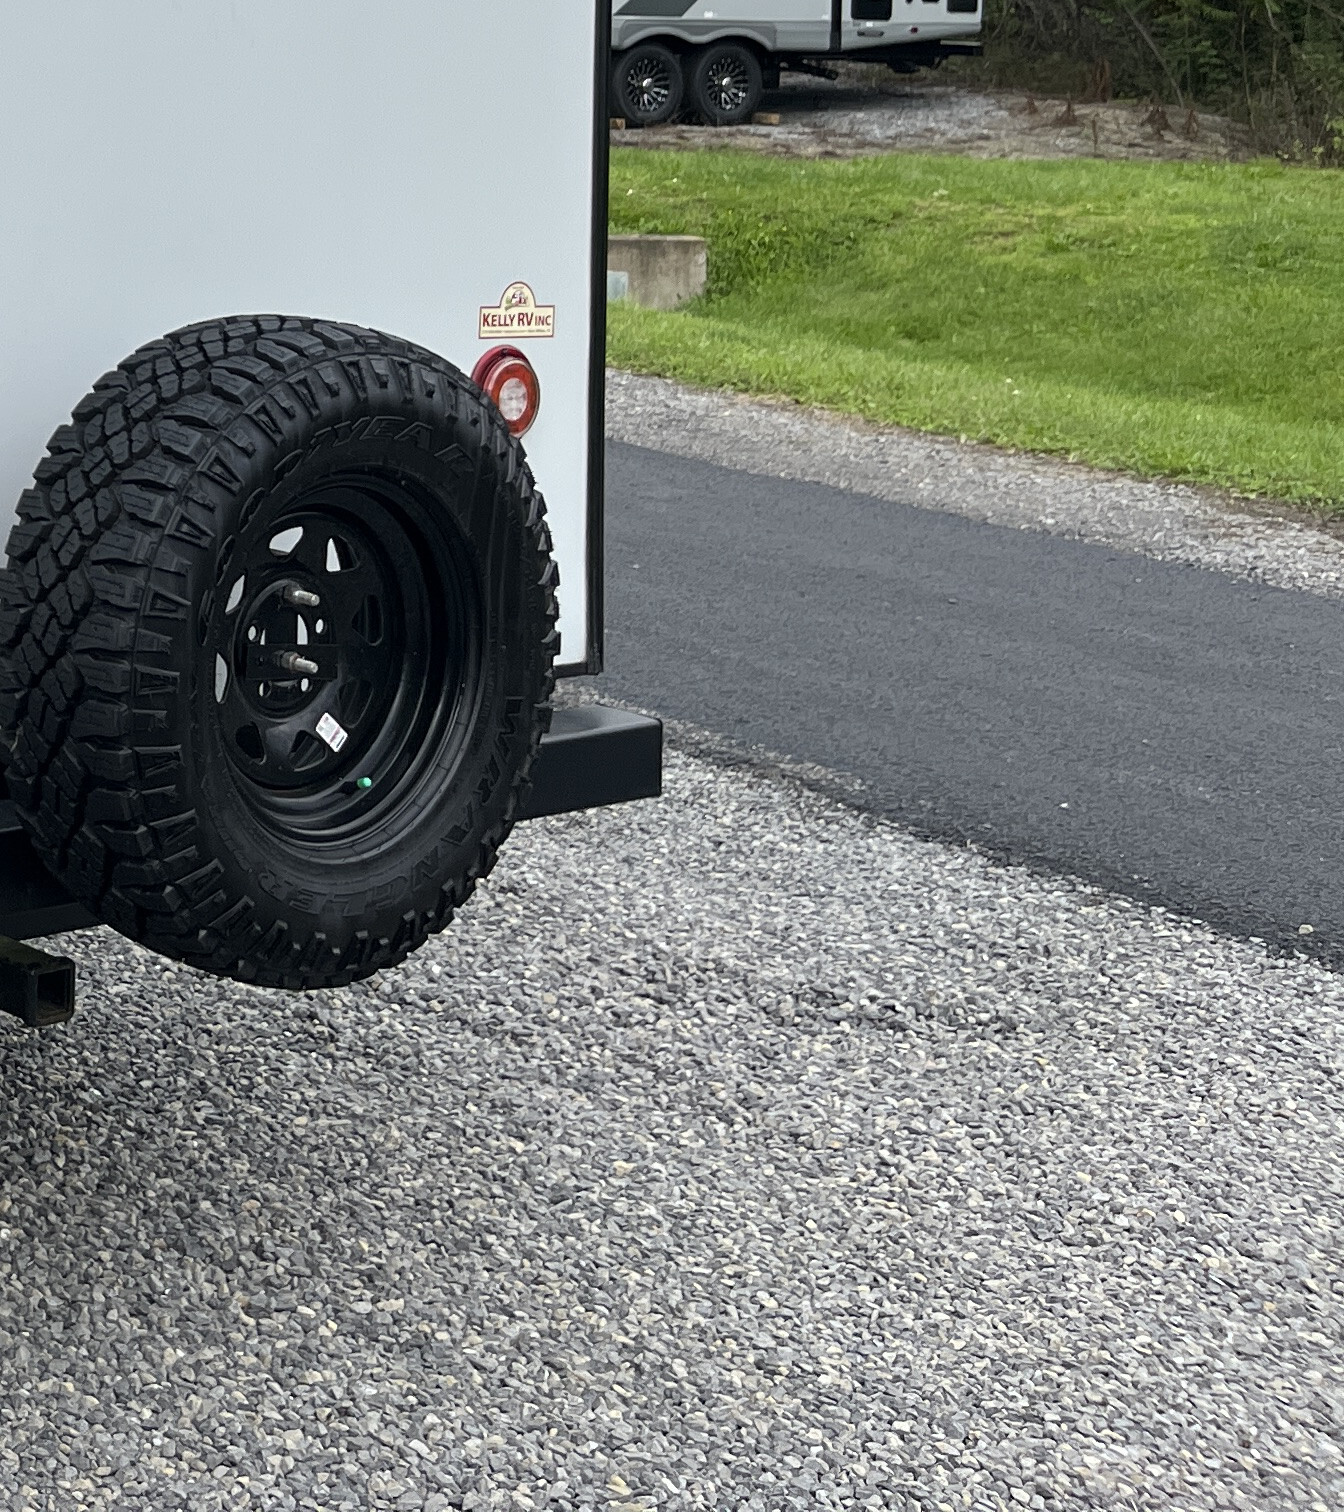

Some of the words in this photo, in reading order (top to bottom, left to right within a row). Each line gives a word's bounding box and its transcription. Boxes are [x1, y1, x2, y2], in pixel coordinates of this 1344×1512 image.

[482, 313, 515, 327] KELLY
[517, 312, 534, 327] RV
[535, 315, 552, 327] INC
